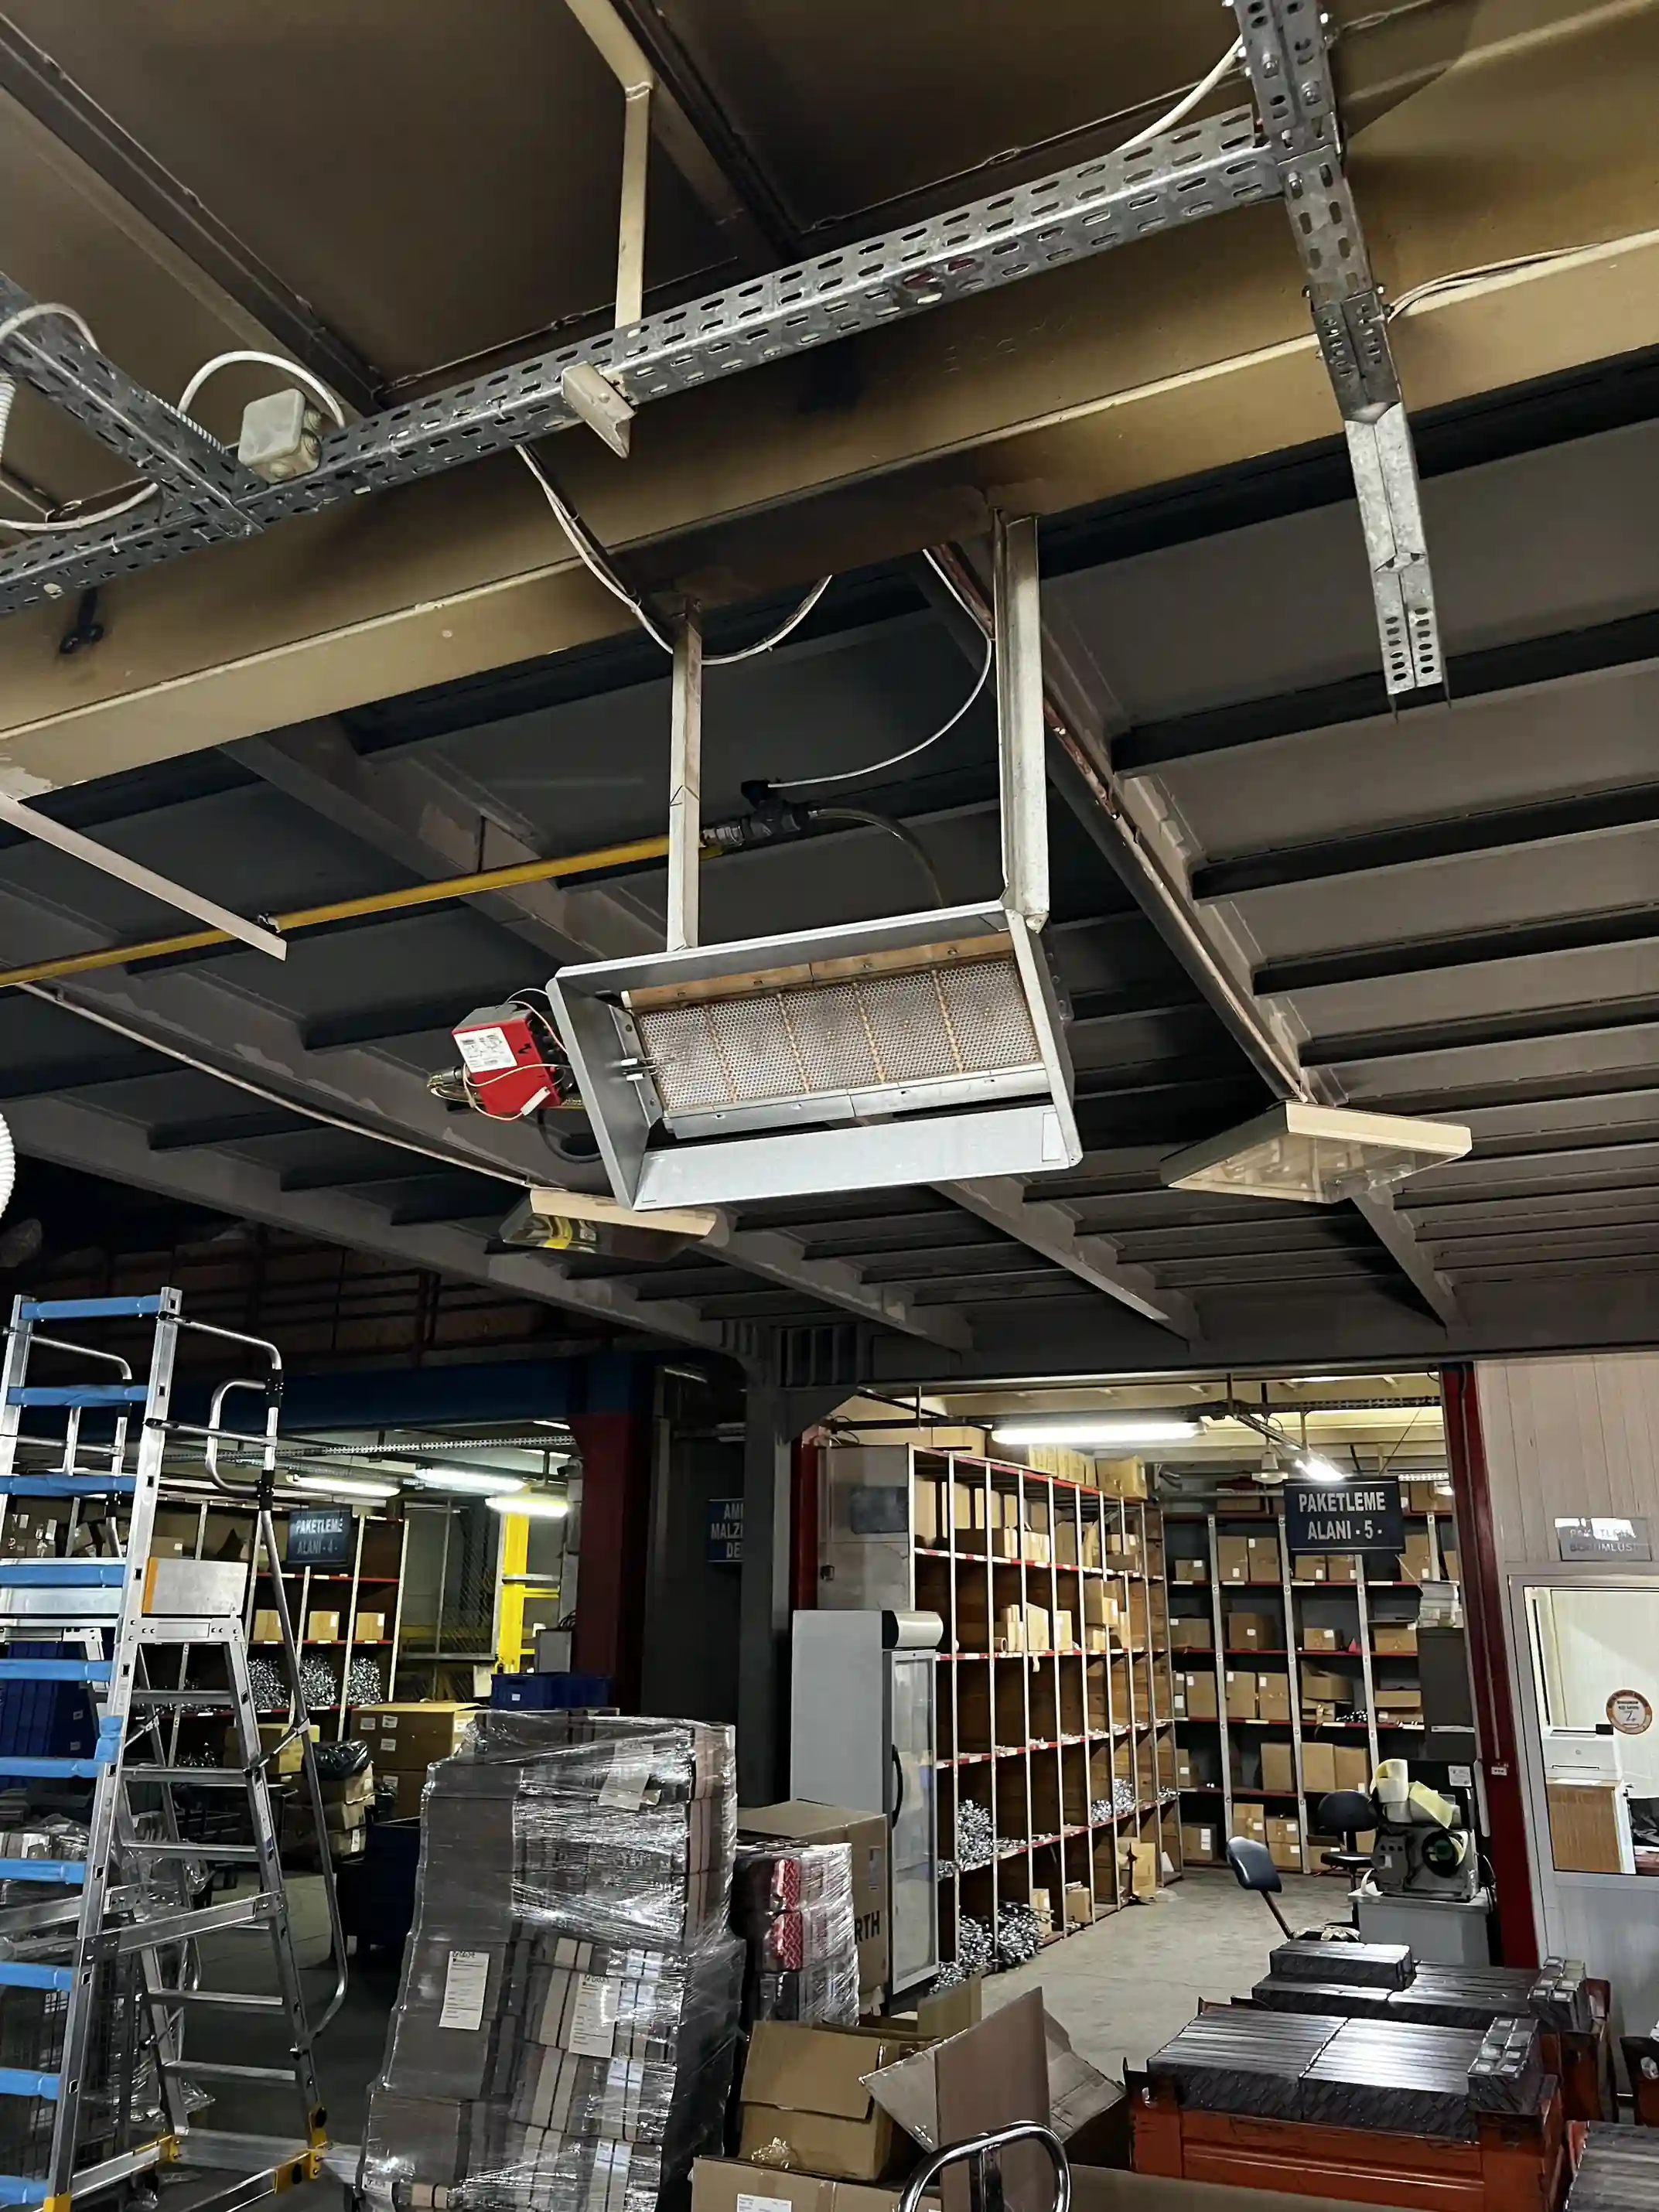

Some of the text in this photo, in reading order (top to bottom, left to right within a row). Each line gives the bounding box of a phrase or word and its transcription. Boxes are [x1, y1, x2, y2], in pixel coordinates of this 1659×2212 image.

[1299, 1492, 1386, 1512] PAKETLEME
[295, 1517, 343, 1534] PAKETLEME
[1308, 1521, 1352, 1540] ALANI
[297, 1539, 322, 1555] ALANI
[855, 1910, 880, 1944] RTH
